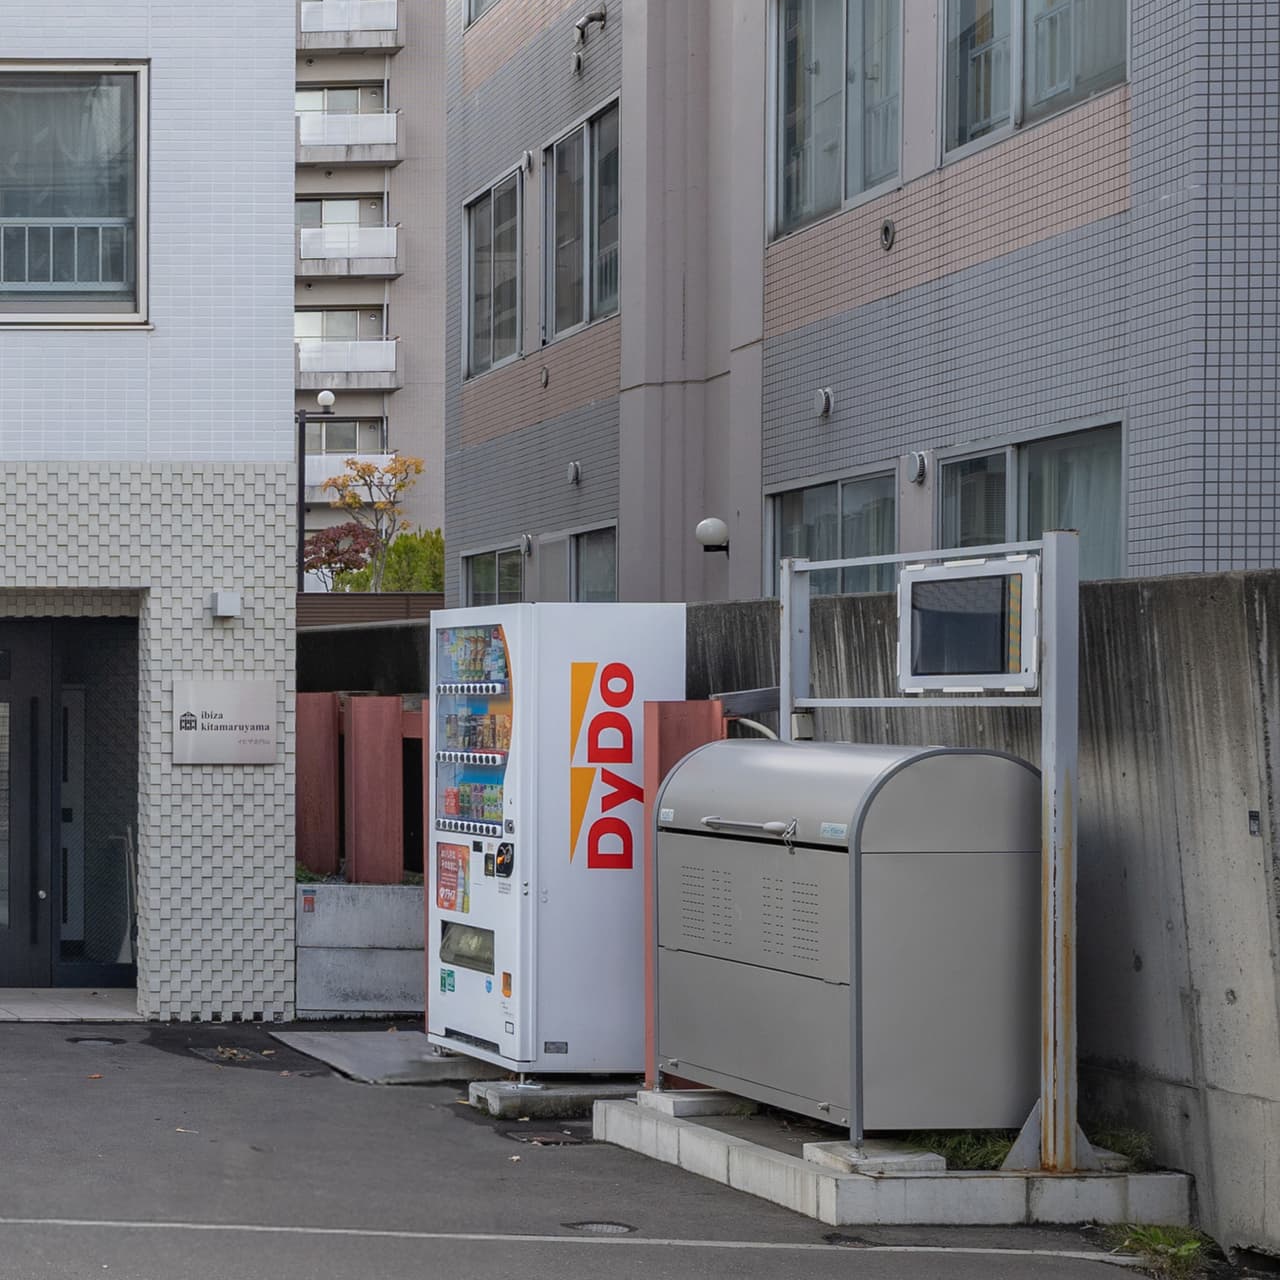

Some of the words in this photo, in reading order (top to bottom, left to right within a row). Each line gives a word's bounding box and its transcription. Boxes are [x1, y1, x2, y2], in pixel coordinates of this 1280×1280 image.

[201, 710, 224, 720] ibiza
[201, 722, 271, 734] kitamaruyama
[587, 662, 645, 869] DyDo
